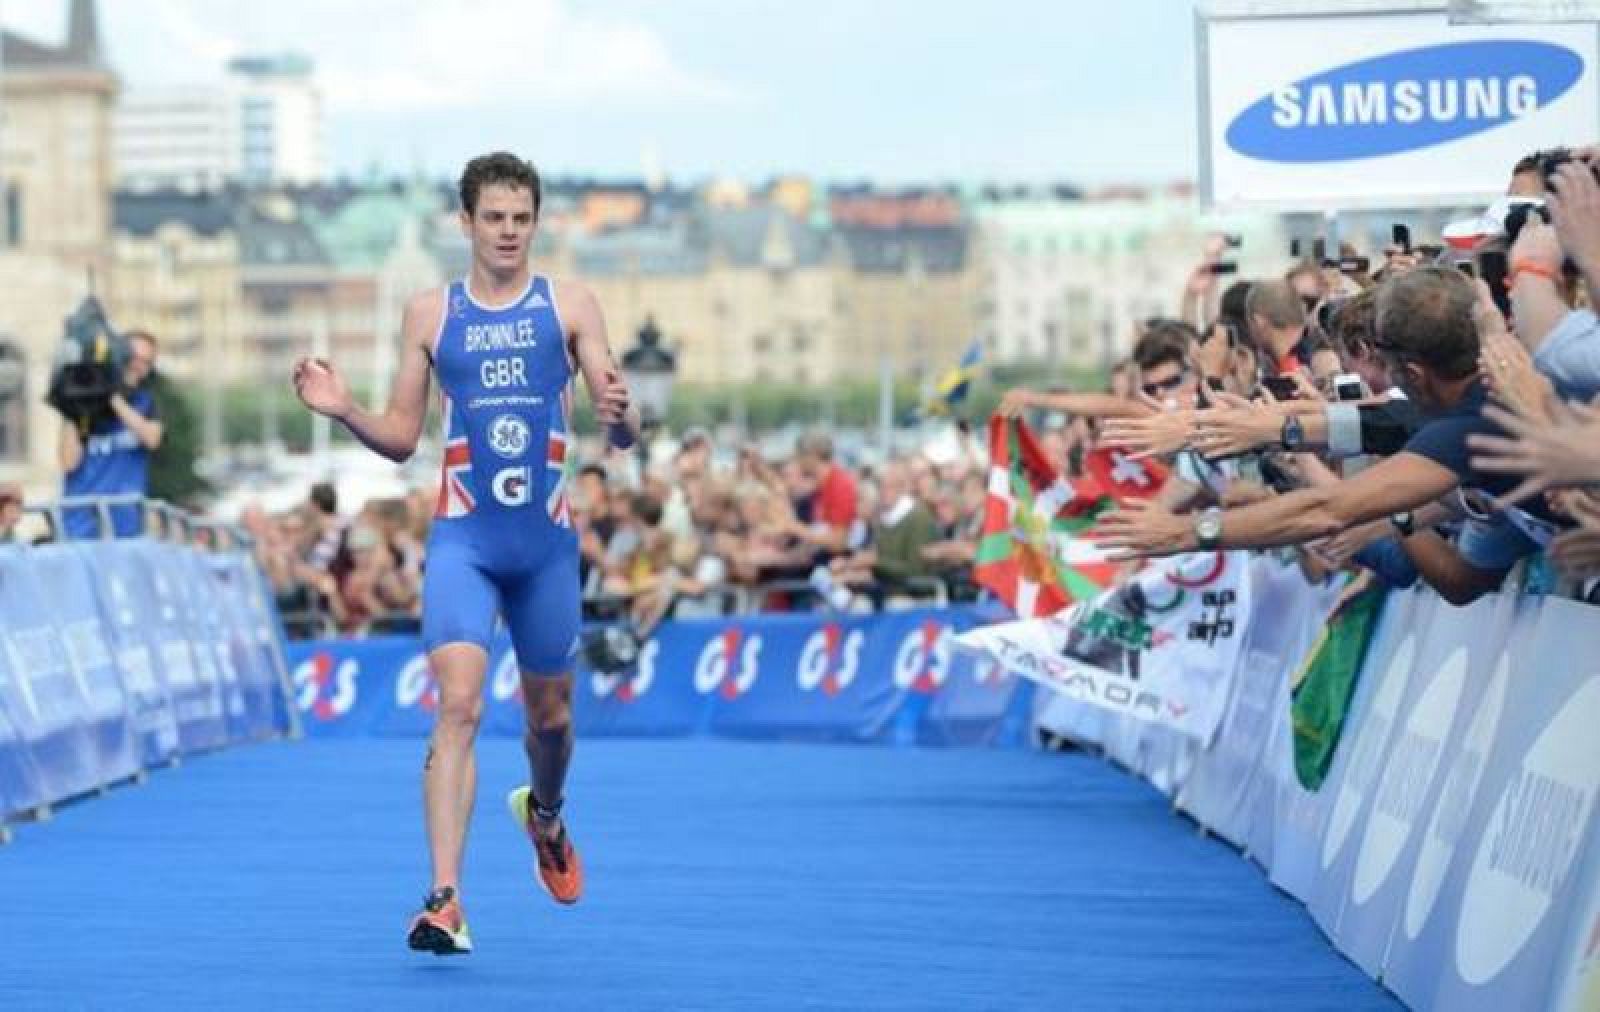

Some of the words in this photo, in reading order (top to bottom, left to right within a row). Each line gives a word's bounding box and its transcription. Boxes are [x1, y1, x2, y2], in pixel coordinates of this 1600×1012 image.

[1271, 75, 1538, 128] SAMSUNG
[464, 318, 537, 353] BROWNLEE
[480, 357, 529, 388] GBR
